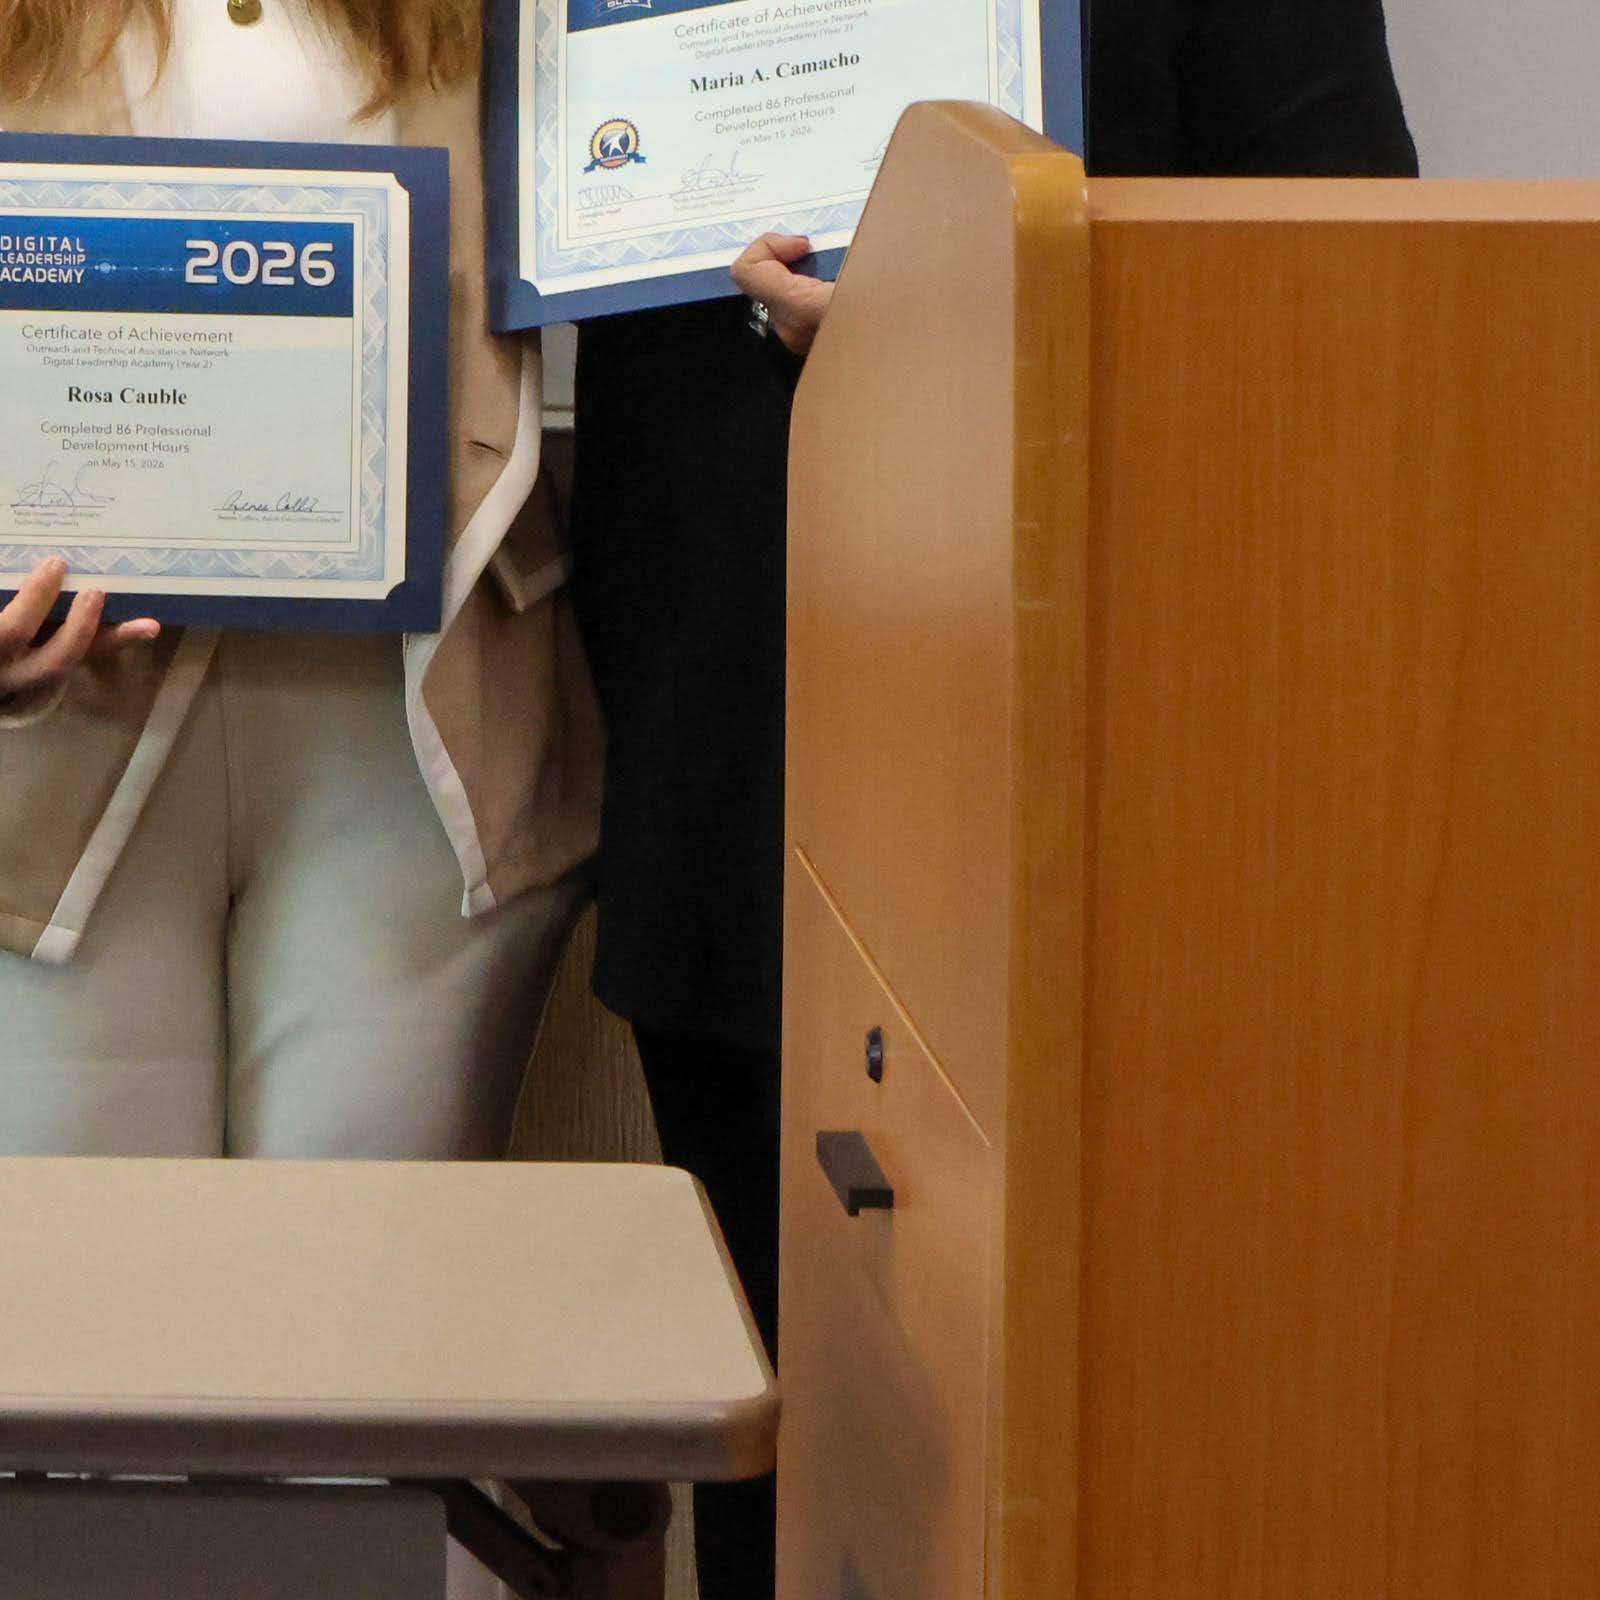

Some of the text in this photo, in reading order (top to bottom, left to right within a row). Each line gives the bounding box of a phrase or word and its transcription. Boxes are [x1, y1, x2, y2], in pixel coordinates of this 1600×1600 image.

[674, 16, 751, 38] Certificate
[754, 10, 770, 24] of
[690, 52, 860, 93] Maria A. Camacho
[695, 85, 855, 122] Completed 86 Professional
[715, 106, 835, 134] Development Hours
[754, 134, 771, 145] May
[0, 236, 85, 251] DIGITAL
[0, 253, 85, 265] LEADERSHIP
[185, 240, 335, 286] 2026
[0, 268, 85, 283] ACADEMY
[22, 325, 233, 343] Certificate of Achievement
[68, 386, 187, 405] Rosa Cauble
[40, 421, 211, 437] Completed 86 Professional
[62, 439, 189, 454] Development Hours
[103, 459, 120, 469] May
